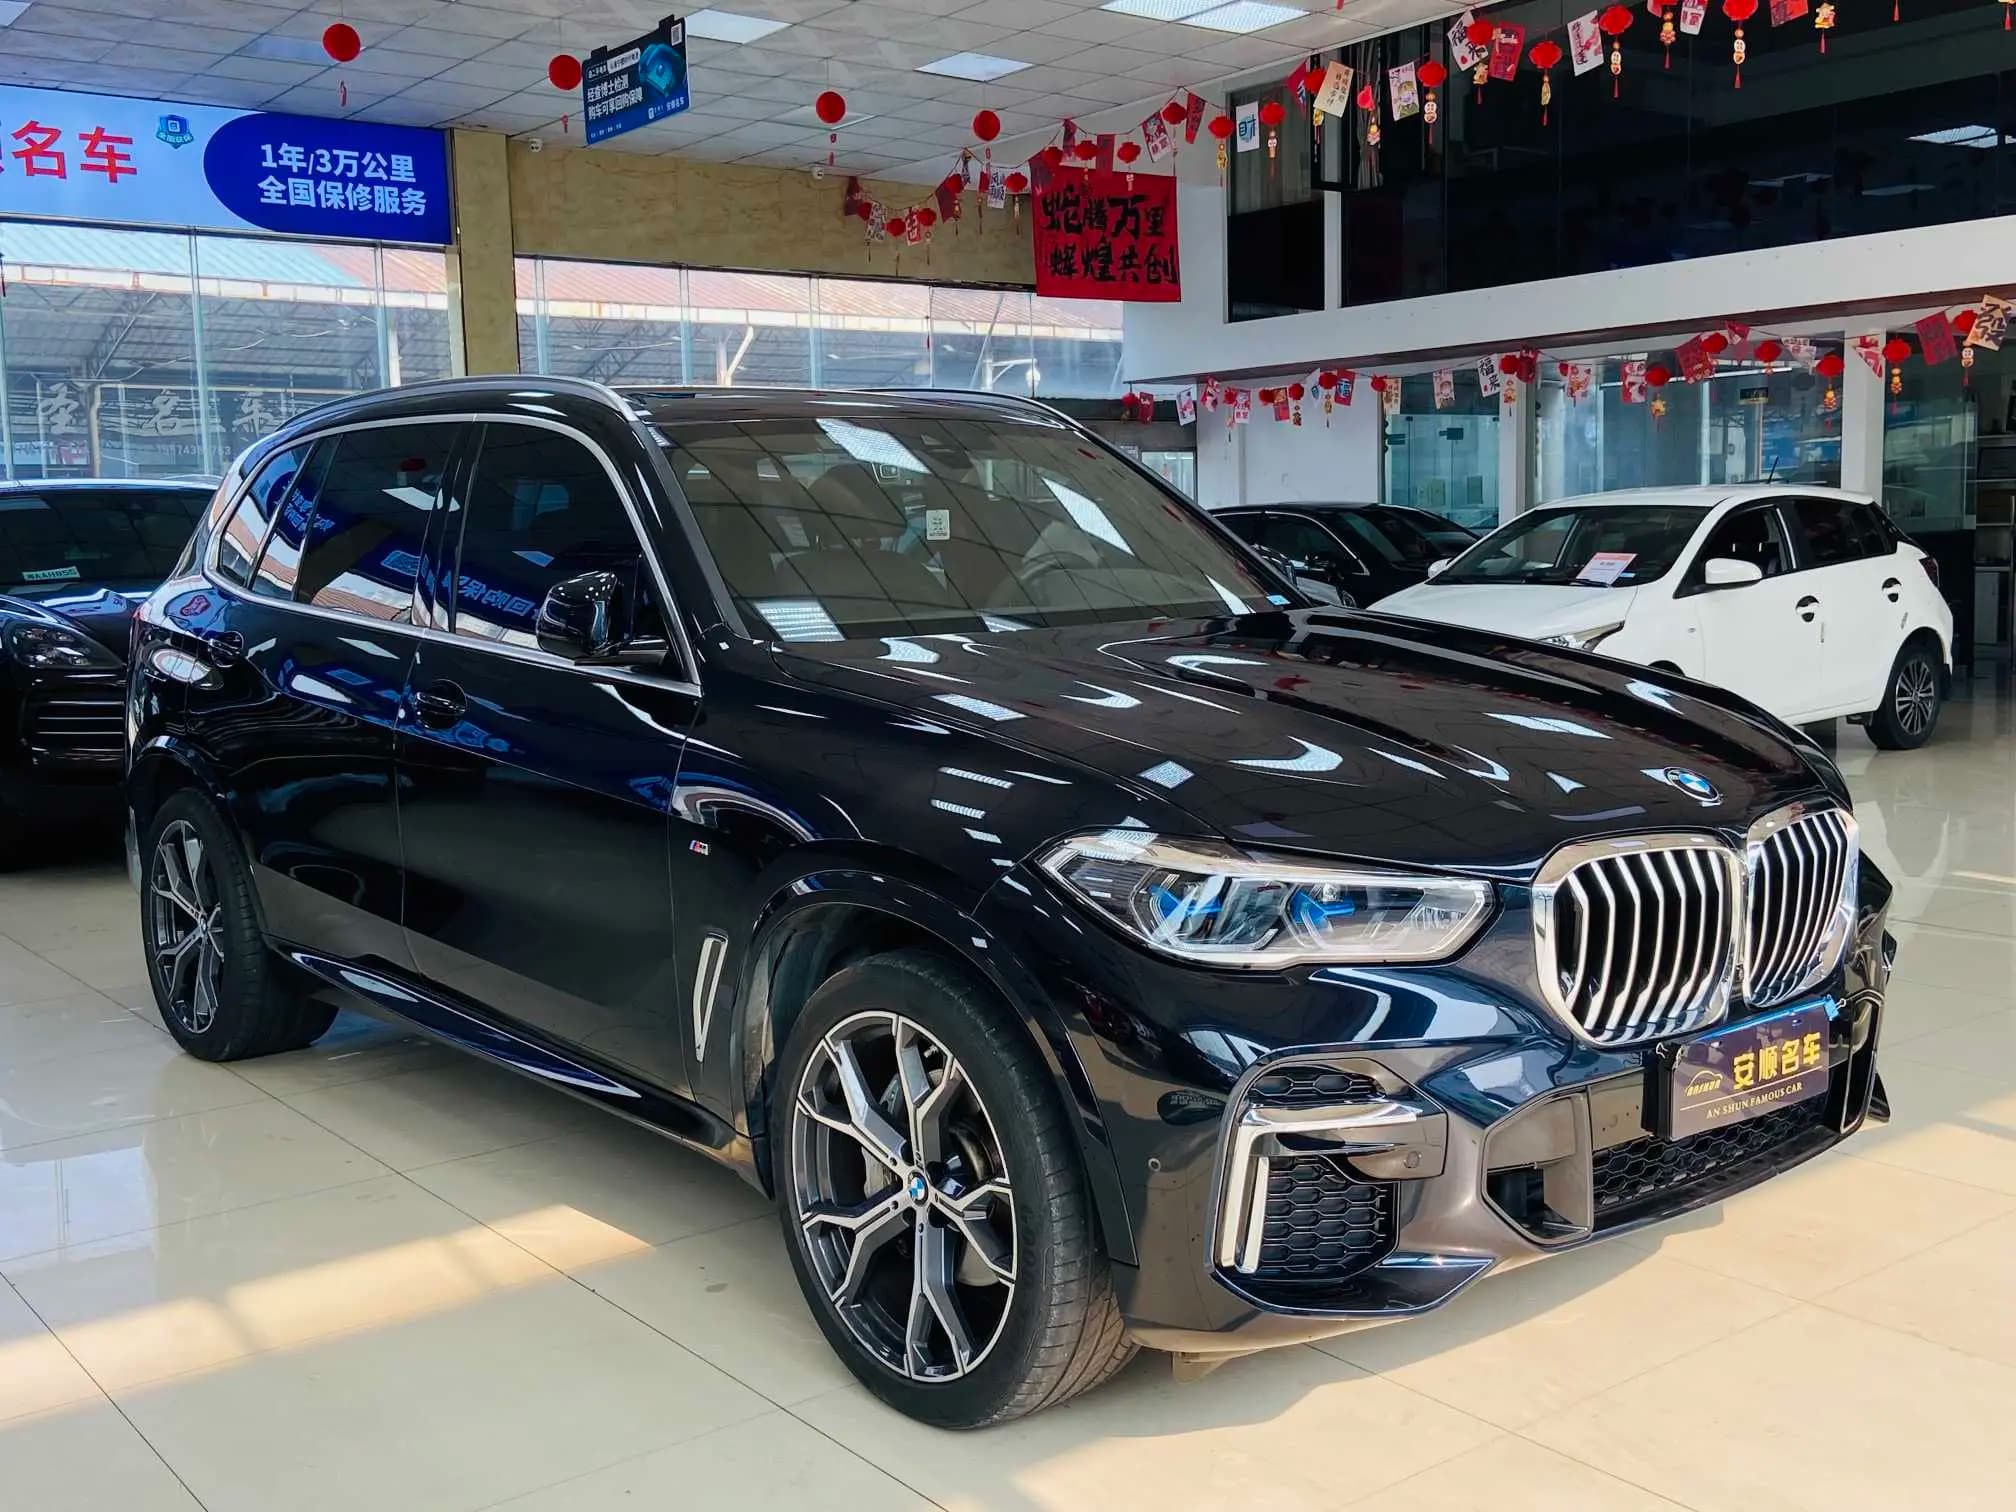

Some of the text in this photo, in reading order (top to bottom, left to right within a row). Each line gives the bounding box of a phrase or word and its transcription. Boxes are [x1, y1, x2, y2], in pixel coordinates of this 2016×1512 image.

[0, 118, 139, 185] 名车
[260, 143, 417, 185] 1年/3万公里
[257, 178, 428, 217] 全国保修服务
[1041, 184, 1167, 241] 蛇腾万里
[1049, 237, 1179, 285] 辉煌共创
[1733, 1031, 1821, 1090] 安顺名车
[1706, 1081, 1803, 1120] AN SHUN FAMOUS CAR
